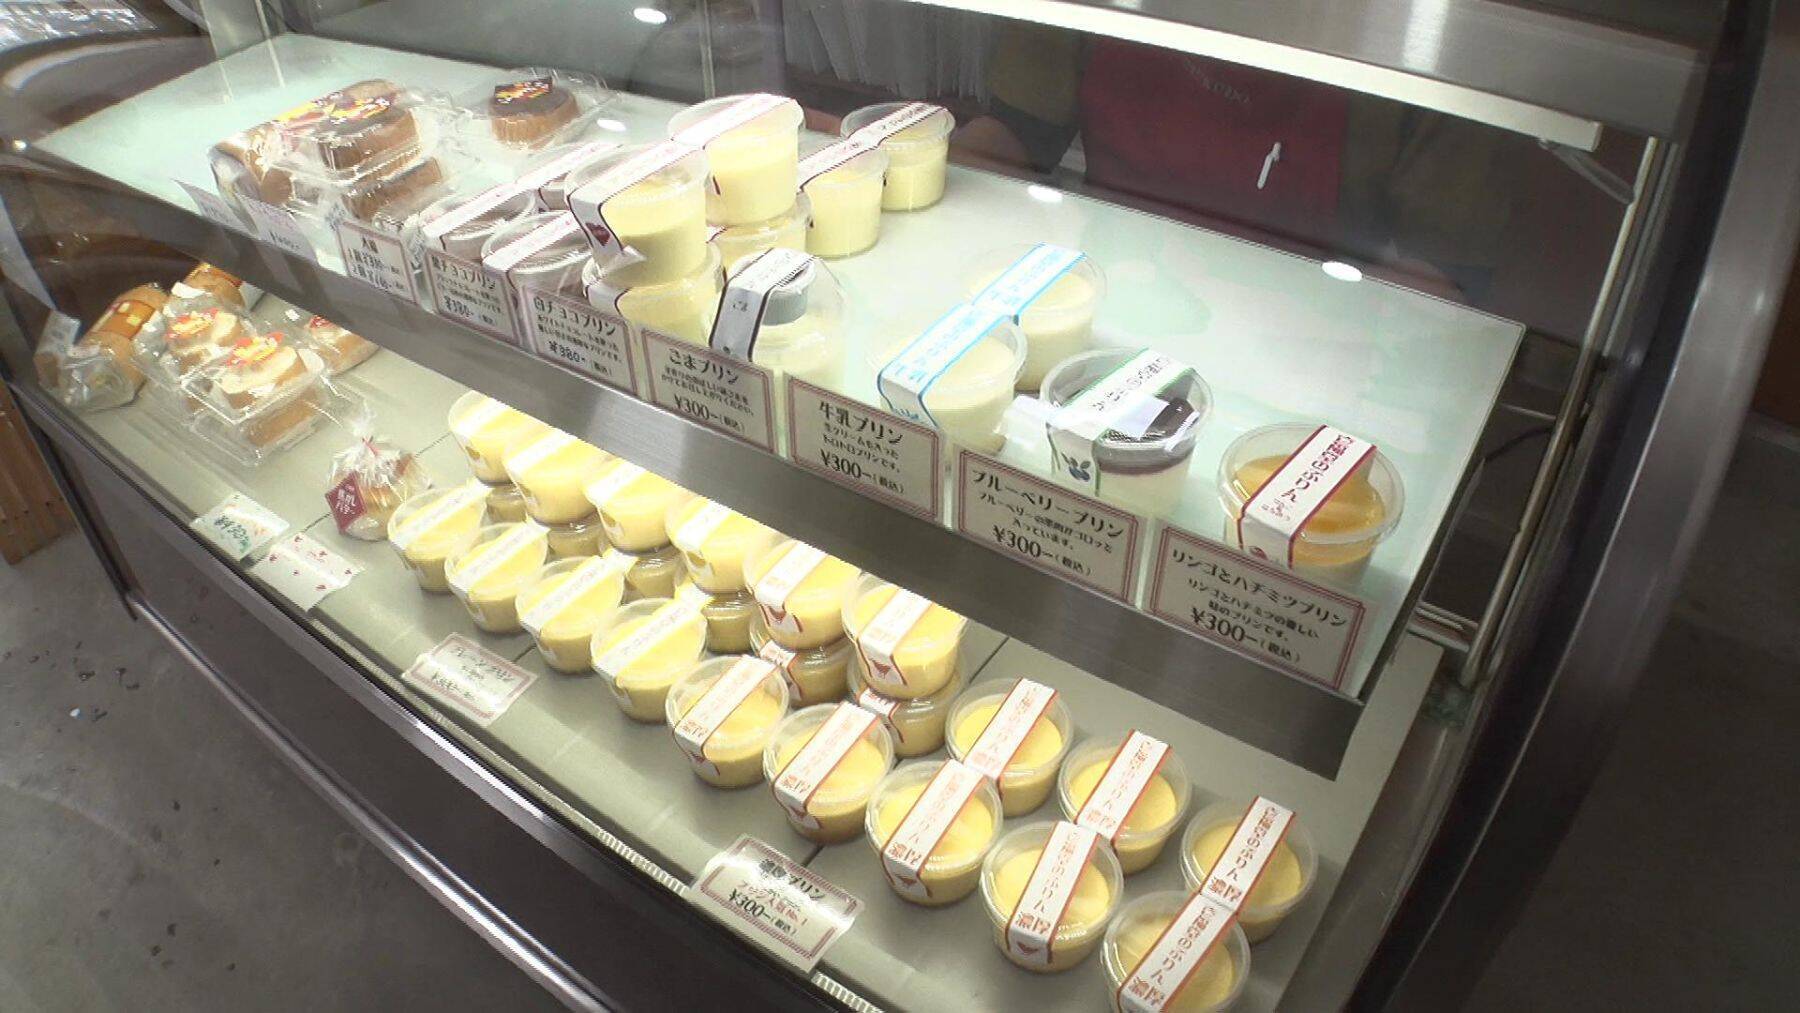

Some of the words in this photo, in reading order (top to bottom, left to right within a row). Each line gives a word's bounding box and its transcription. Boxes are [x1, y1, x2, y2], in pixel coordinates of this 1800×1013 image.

[669, 347, 740, 385] ごまプリン
[819, 401, 903, 445] 牛乳プリン
[972, 469, 1125, 538] ブルーベリープリン
[1172, 548, 1348, 627] リンゴとハチミツプリン
